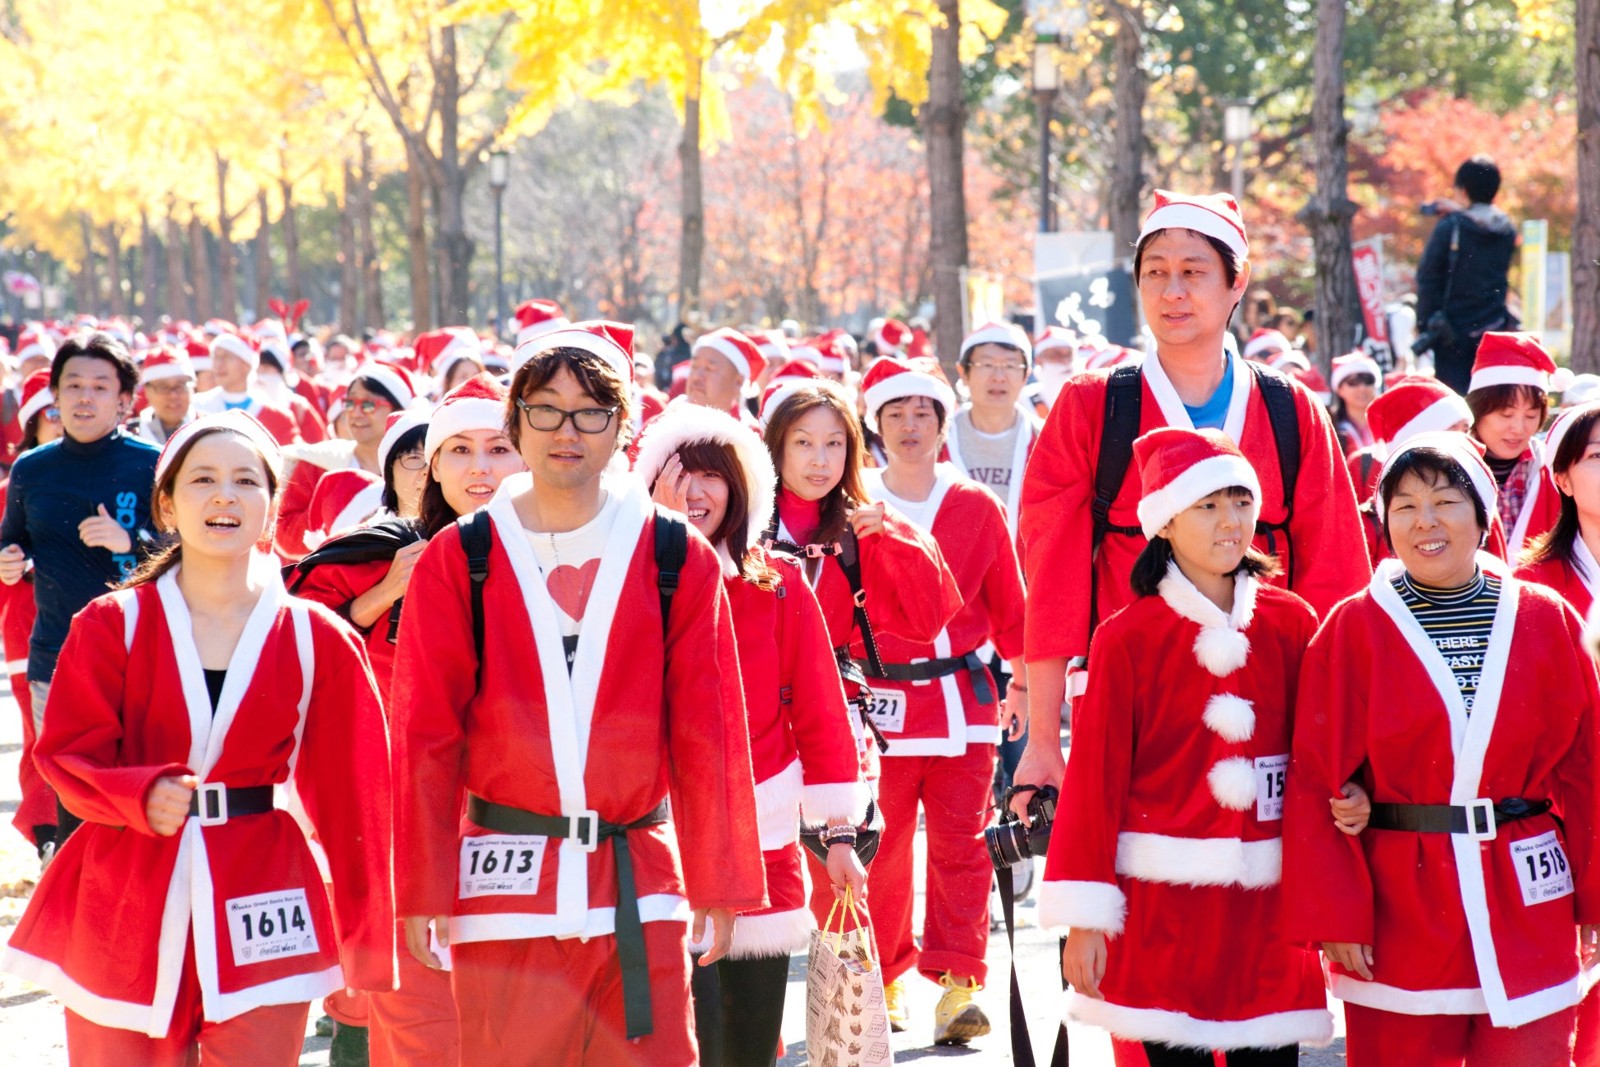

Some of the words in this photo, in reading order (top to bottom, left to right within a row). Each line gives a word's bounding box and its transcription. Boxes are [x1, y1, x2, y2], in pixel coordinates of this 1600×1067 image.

[1266, 770, 1287, 799] 15
[470, 849, 534, 875] 1613
[1526, 847, 1566, 882] 1518
[242, 905, 305, 941] 1614
